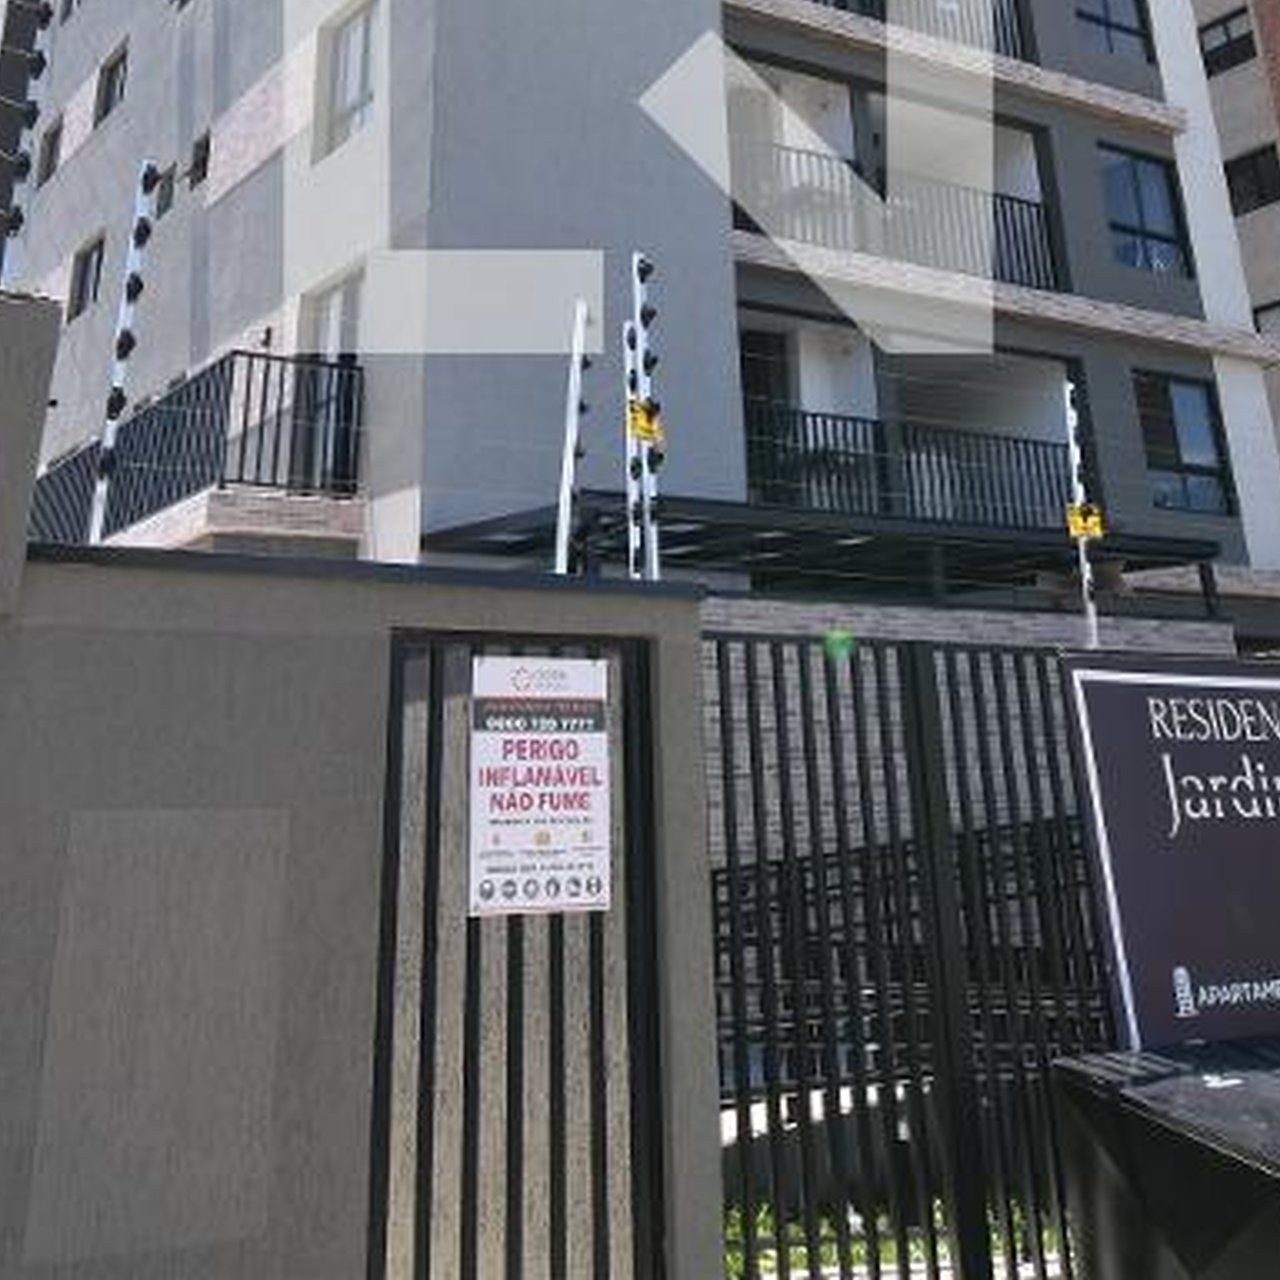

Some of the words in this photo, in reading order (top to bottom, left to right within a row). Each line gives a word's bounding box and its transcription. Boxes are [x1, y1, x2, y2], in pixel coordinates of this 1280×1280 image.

[502, 738, 579, 761] PERIGO
[479, 764, 603, 788] INFLAMÁVEL
[538, 791, 591, 812] FUME
